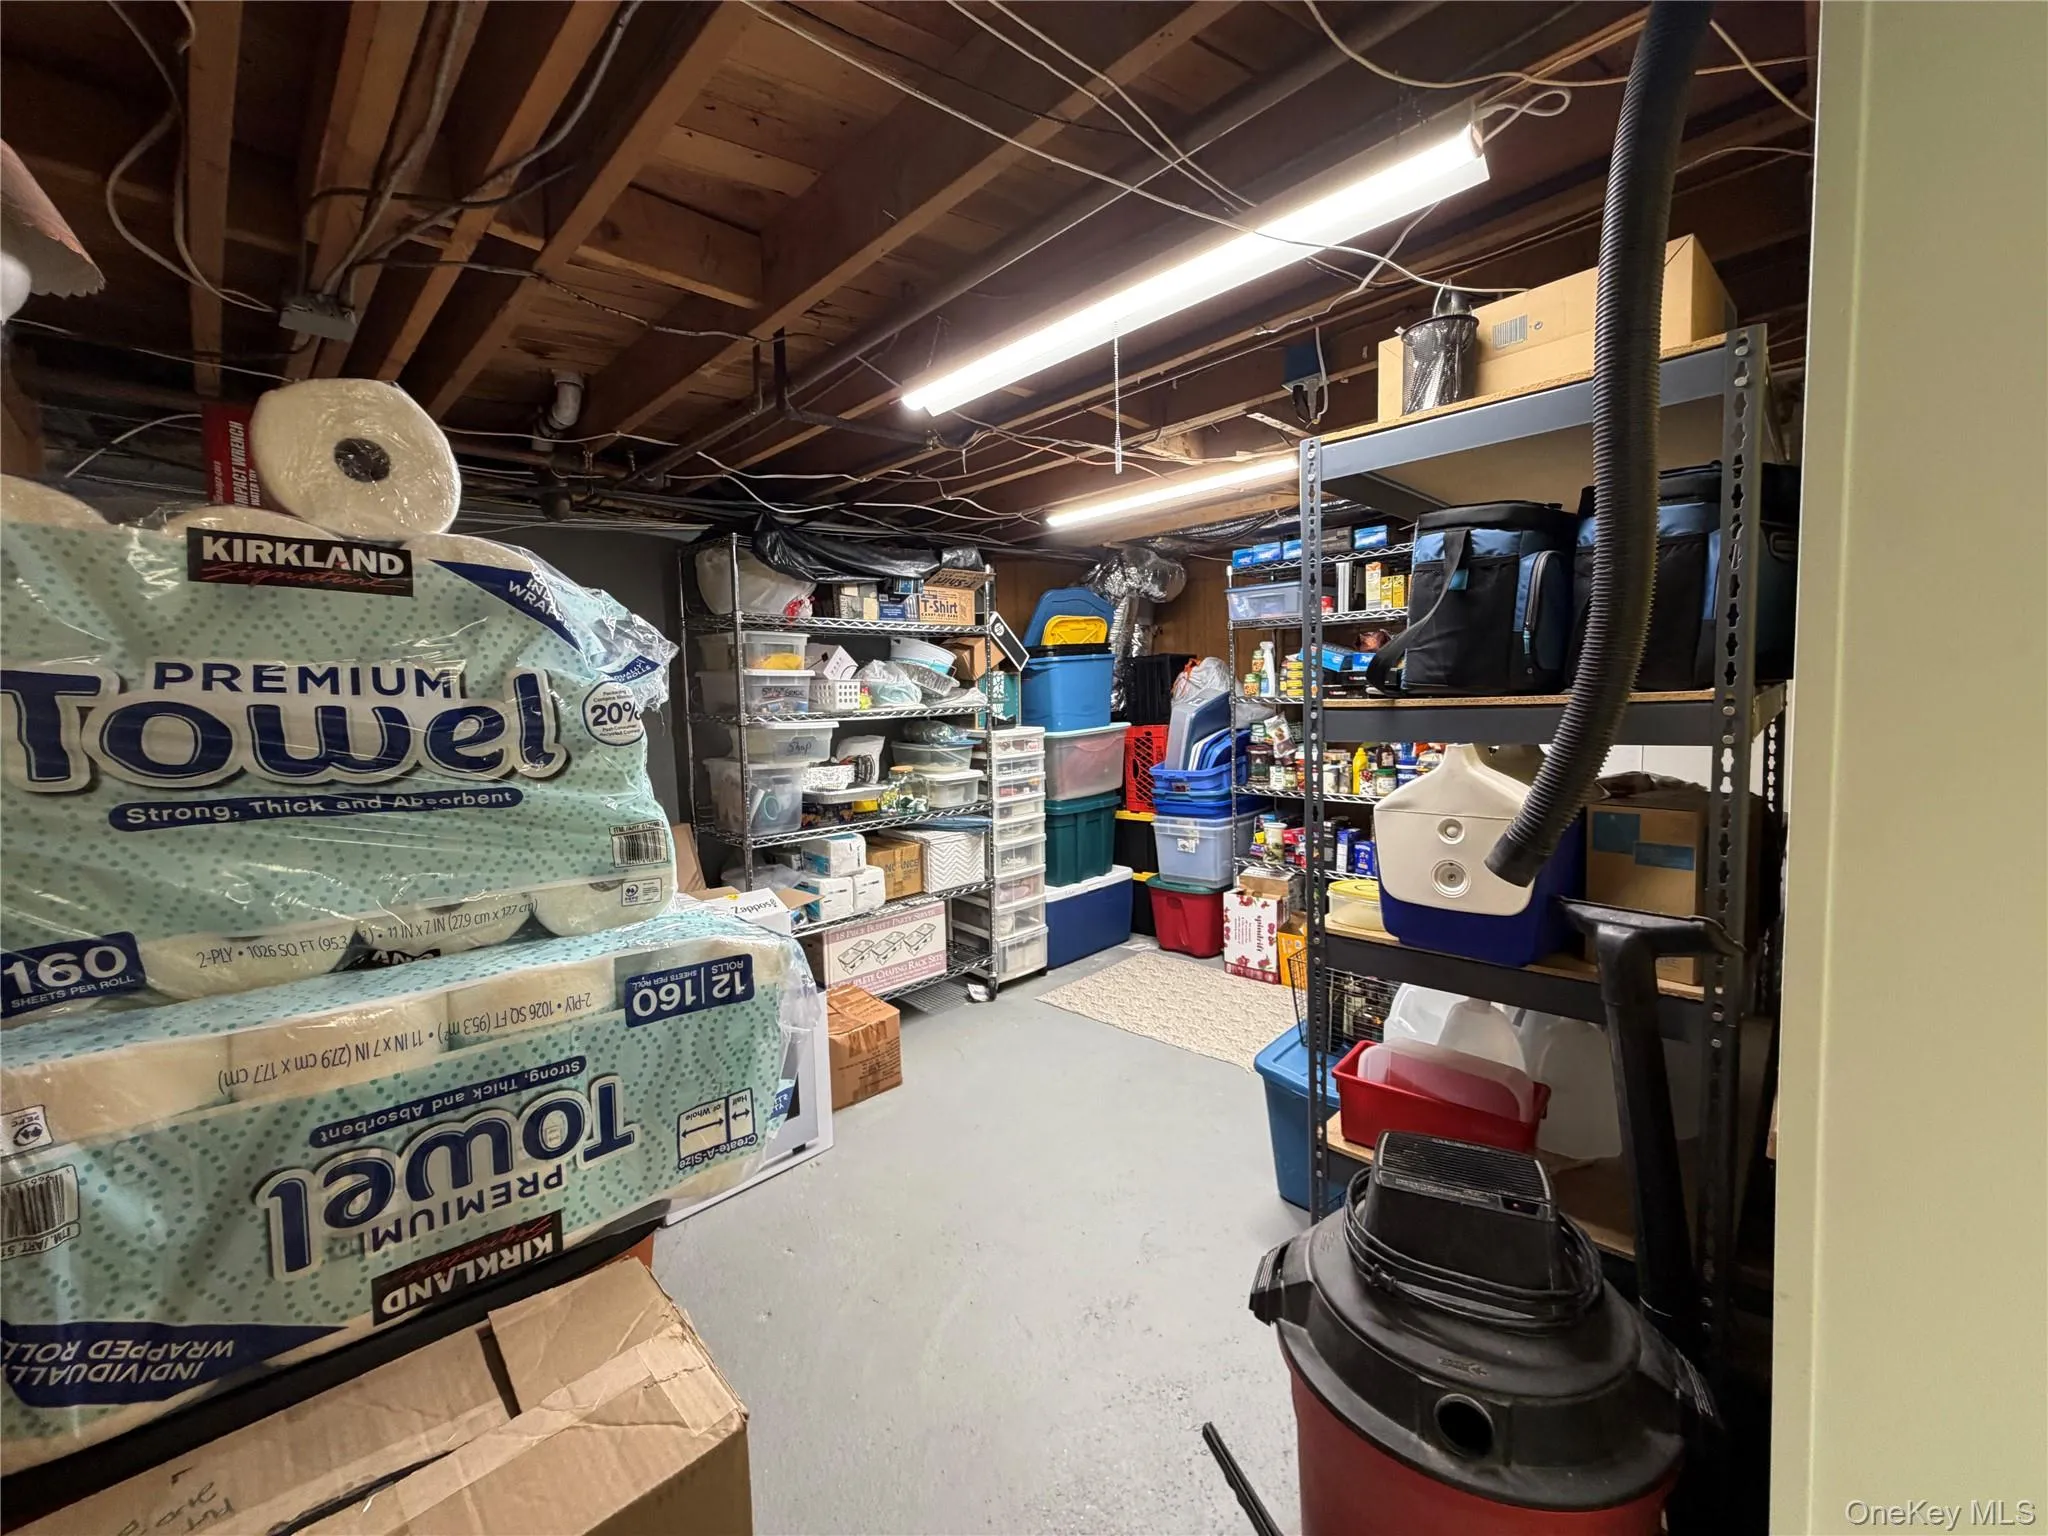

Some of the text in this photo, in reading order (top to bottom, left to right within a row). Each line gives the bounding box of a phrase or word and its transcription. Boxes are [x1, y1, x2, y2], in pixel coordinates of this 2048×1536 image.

[228, 420, 246, 467] WRENCH
[202, 535, 405, 575] KIRKLAND
[921, 600, 958, 614] T-Shirt
[153, 662, 453, 699] PREMIUM
[590, 701, 641, 727] 20%
[0, 670, 558, 782] Towel
[126, 790, 512, 825] Strong, Thick and Absorbent
[730, 901, 771, 914] Zappos
[401, 926, 413, 938] IN
[424, 920, 431, 934] 7
[434, 917, 446, 933] IN
[474, 912, 490, 925] cm
[492, 910, 499, 920] x
[196, 946, 233, 968] 2-PLY
[247, 945, 277, 959] 1026
[278, 943, 299, 958] SQ
[300, 940, 315, 953] FT
[3, 946, 128, 995] 160
[670, 969, 697, 981] SHEETS
[711, 960, 744, 974] ROLLS
[652, 975, 668, 985] PER
[711, 970, 746, 998] 12
[11, 976, 136, 1009] SHEETS PER ROLL
[564, 992, 592, 1013] 2-PLY
[632, 979, 697, 1017] 160
[494, 1011, 507, 1029] FT
[510, 1006, 527, 1024] SQ
[529, 1001, 554, 1020] 1026
[373, 1039, 381, 1057] 7
[382, 1037, 391, 1051] x
[394, 1032, 408, 1051] IN
[412, 1029, 423, 1047] 11
[295, 1053, 317, 1071] cm
[354, 1042, 370, 1062] IN
[253, 1062, 278, 1084] 17.7
[280, 1059, 291, 1074] x
[218, 1068, 248, 1095] cm)
[319, 1060, 581, 1144] Strong, Thick and Absorbent
[732, 1094, 748, 1106] Half
[685, 1107, 711, 1121] Whole
[678, 1134, 757, 1169] Create-A-Size
[269, 1082, 634, 1273] Towel
[371, 1164, 563, 1252] PREMIUM
[381, 1231, 553, 1315] KIRKLAND
[88, 1339, 236, 1360] WRAPPED
